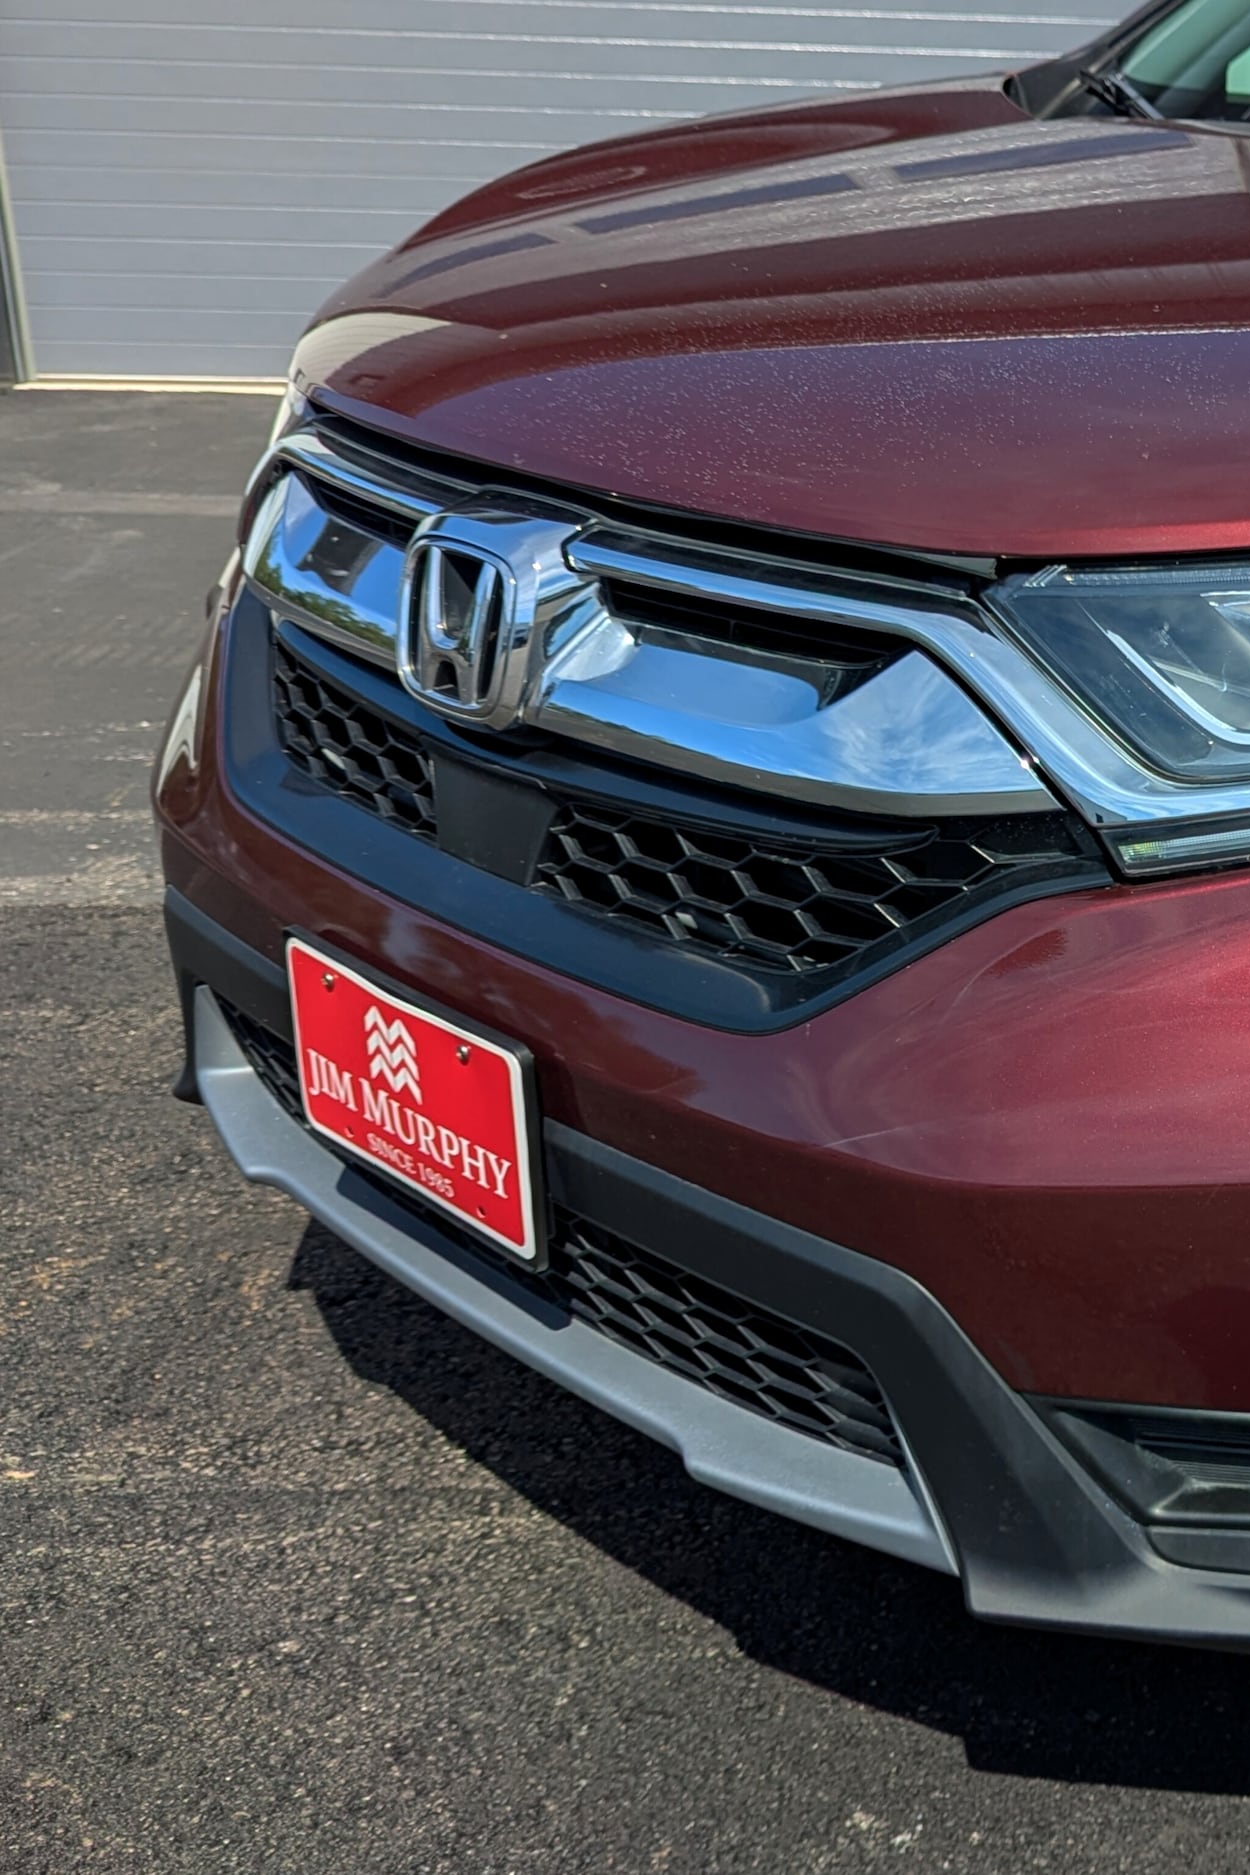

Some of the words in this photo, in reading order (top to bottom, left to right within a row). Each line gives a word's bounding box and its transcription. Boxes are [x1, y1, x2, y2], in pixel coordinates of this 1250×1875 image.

[307, 1048, 358, 1112] JIM
[359, 1078, 512, 1199] MURPHY
[366, 1132, 416, 1175] SINCE
